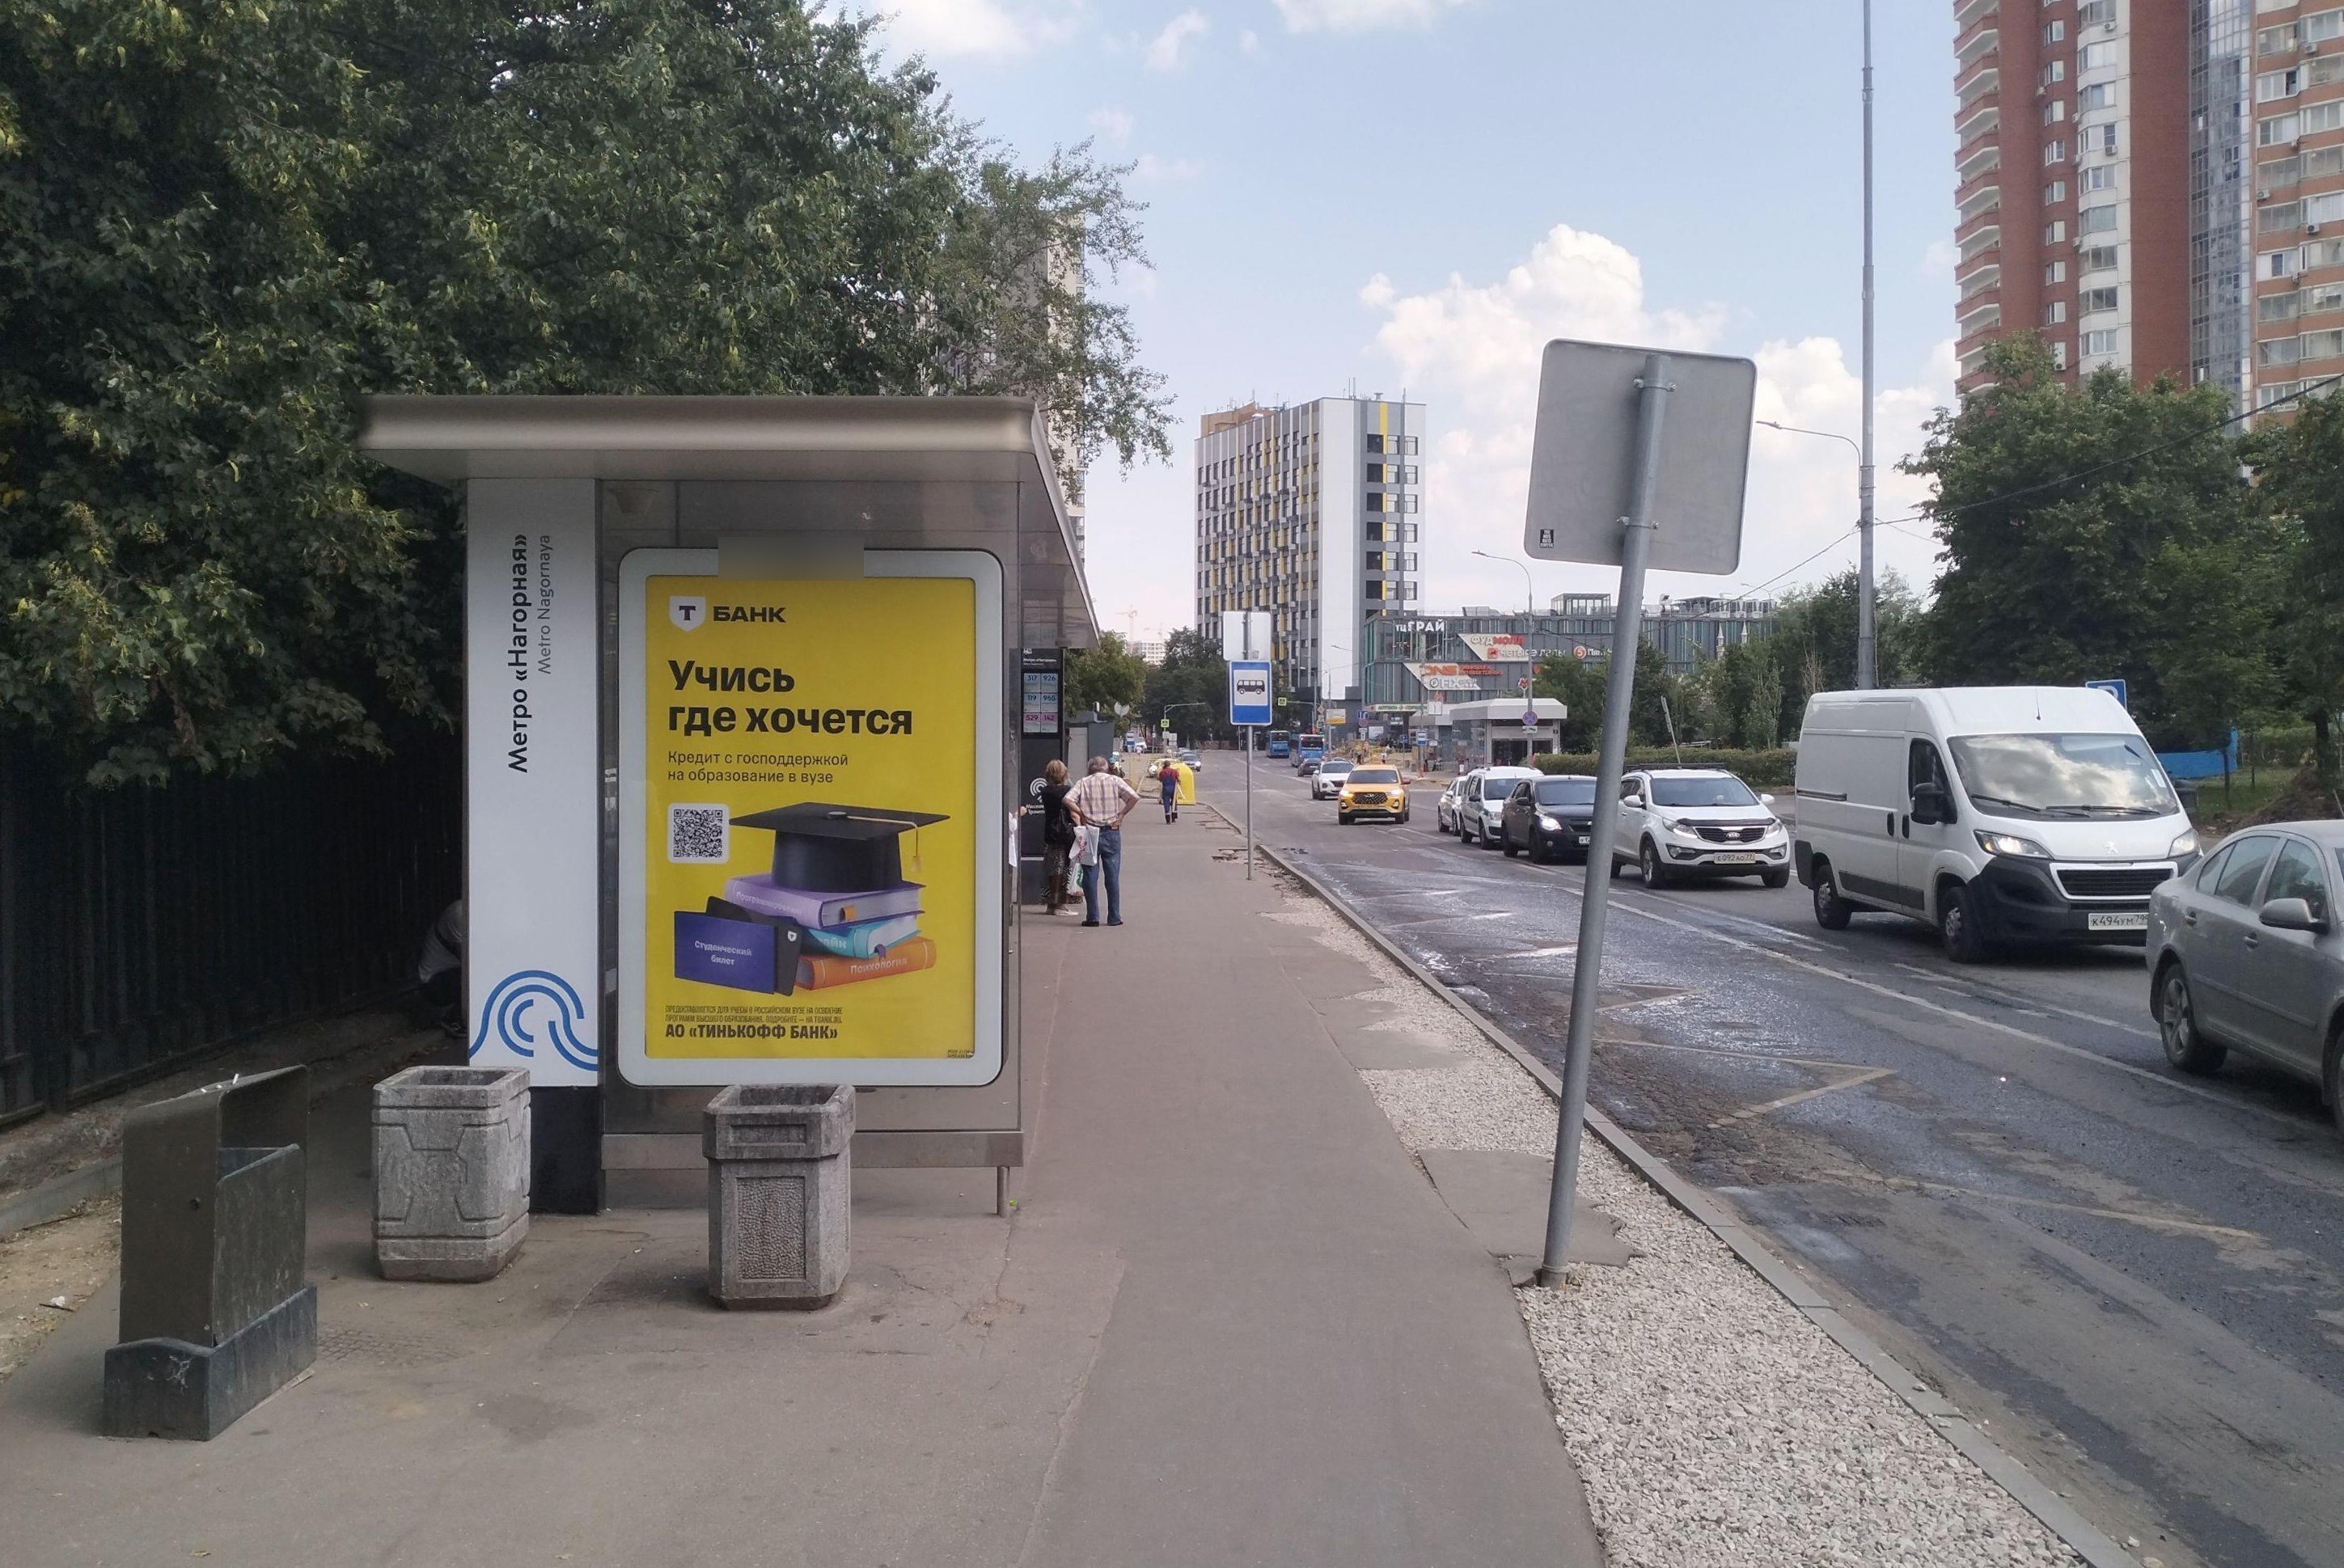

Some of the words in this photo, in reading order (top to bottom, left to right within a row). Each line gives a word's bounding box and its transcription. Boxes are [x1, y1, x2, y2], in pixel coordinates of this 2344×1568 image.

[537, 535, 554, 619] Nagornaya
[508, 534, 532, 682] «Нагорная»
[713, 606, 786, 623] БАНК
[537, 625, 551, 674] Metro
[668, 660, 796, 693] Учись
[508, 688, 532, 773] Метро
[669, 707, 737, 737] где
[745, 708, 913, 735] хочется
[668, 750, 720, 765] Кредит
[725, 753, 732, 763] с
[737, 752, 848, 767] господдержкой
[668, 769, 684, 781] на
[688, 768, 784, 784] образование
[789, 771, 797, 782] в
[801, 771, 833, 785] вузе
[694, 940, 752, 957] Студенческий
[711, 954, 735, 966] билет
[850, 956, 908, 974] Психология
[665, 1024, 685, 1038] АО
[689, 1024, 786, 1039] «ТИНЬКОФФ
[790, 1025, 838, 1039] БАНК»
